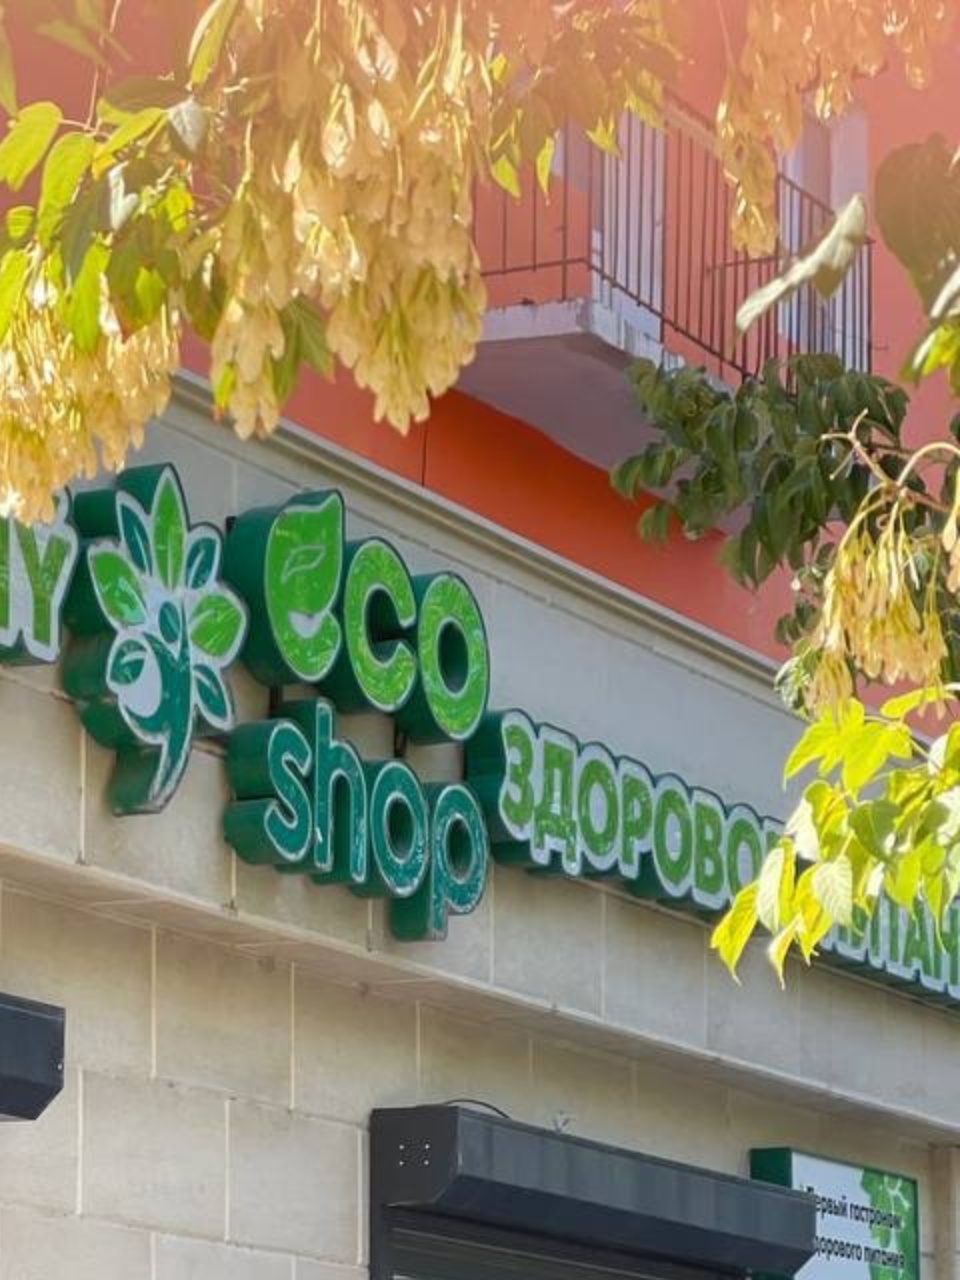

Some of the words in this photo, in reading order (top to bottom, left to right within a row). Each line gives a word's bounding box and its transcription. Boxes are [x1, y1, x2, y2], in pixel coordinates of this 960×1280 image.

[265, 490, 489, 740] eco
[264, 697, 489, 938] shop
[807, 1186, 848, 1220] ервый
